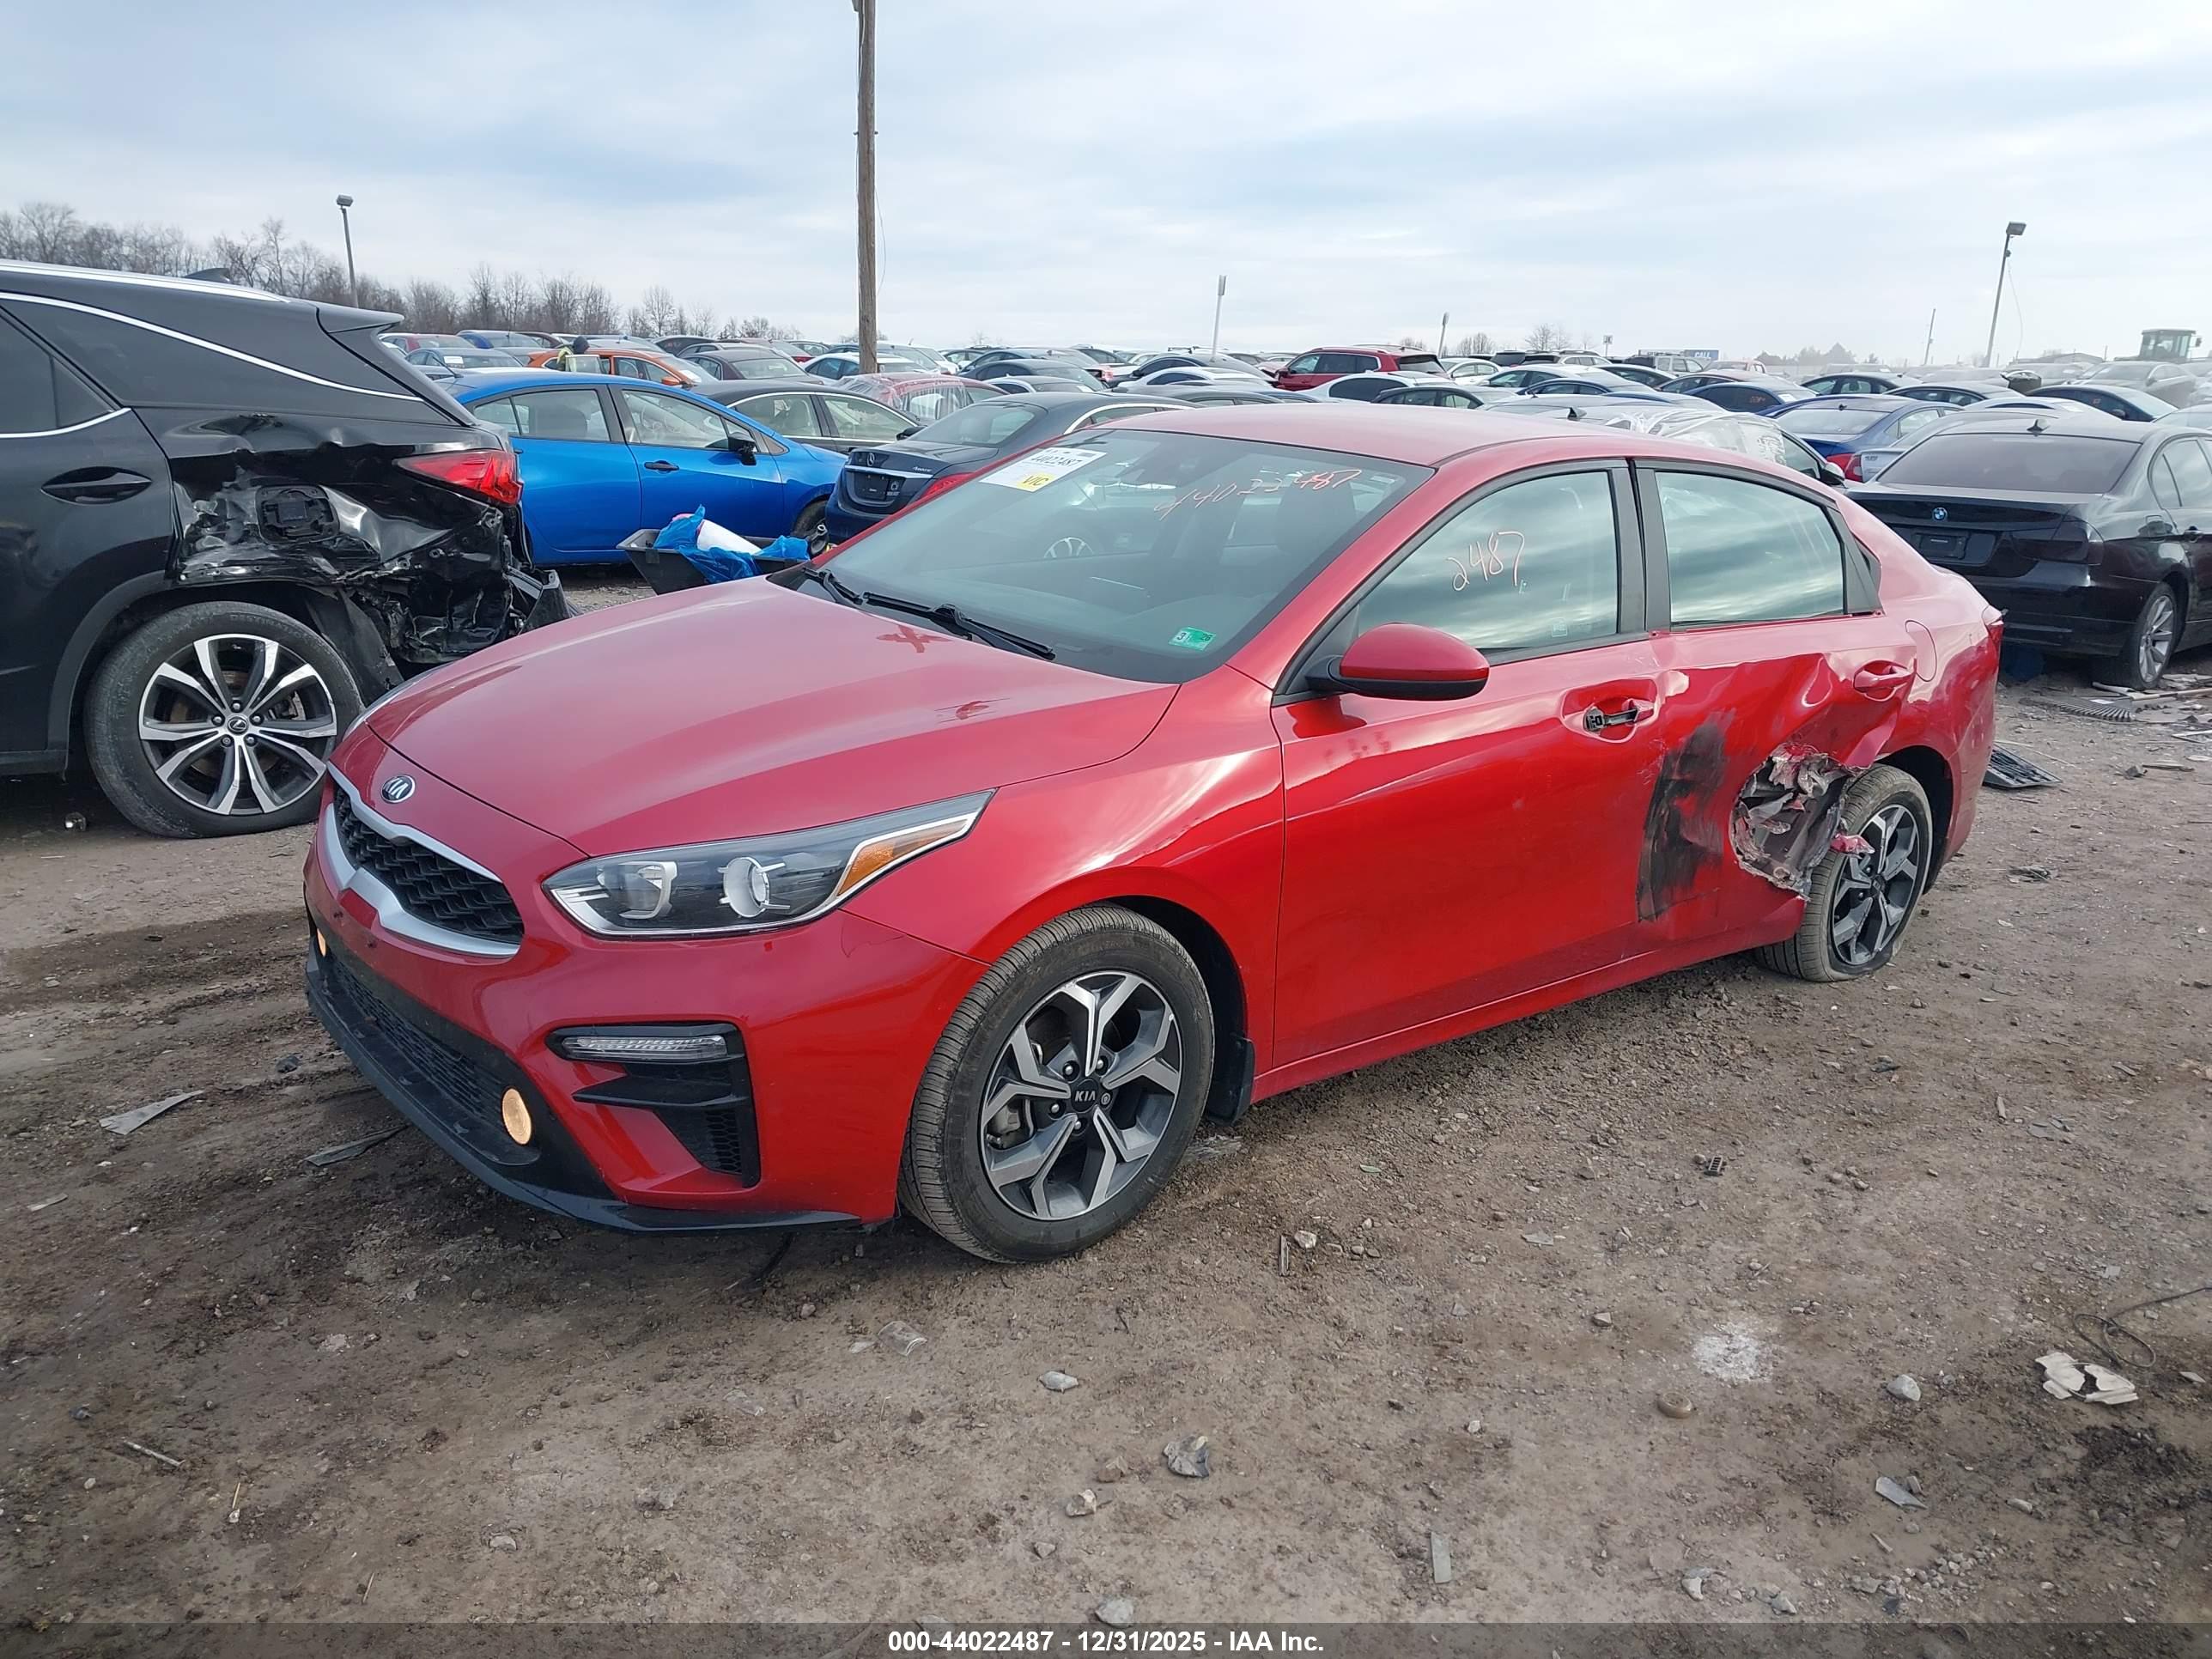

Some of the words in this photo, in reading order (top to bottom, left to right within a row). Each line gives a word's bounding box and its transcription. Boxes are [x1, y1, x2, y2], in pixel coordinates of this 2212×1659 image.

[1023, 475, 1049, 487] VIC
[1445, 531, 1525, 592] 2487
[1075, 1091, 1096, 1102] KIA
